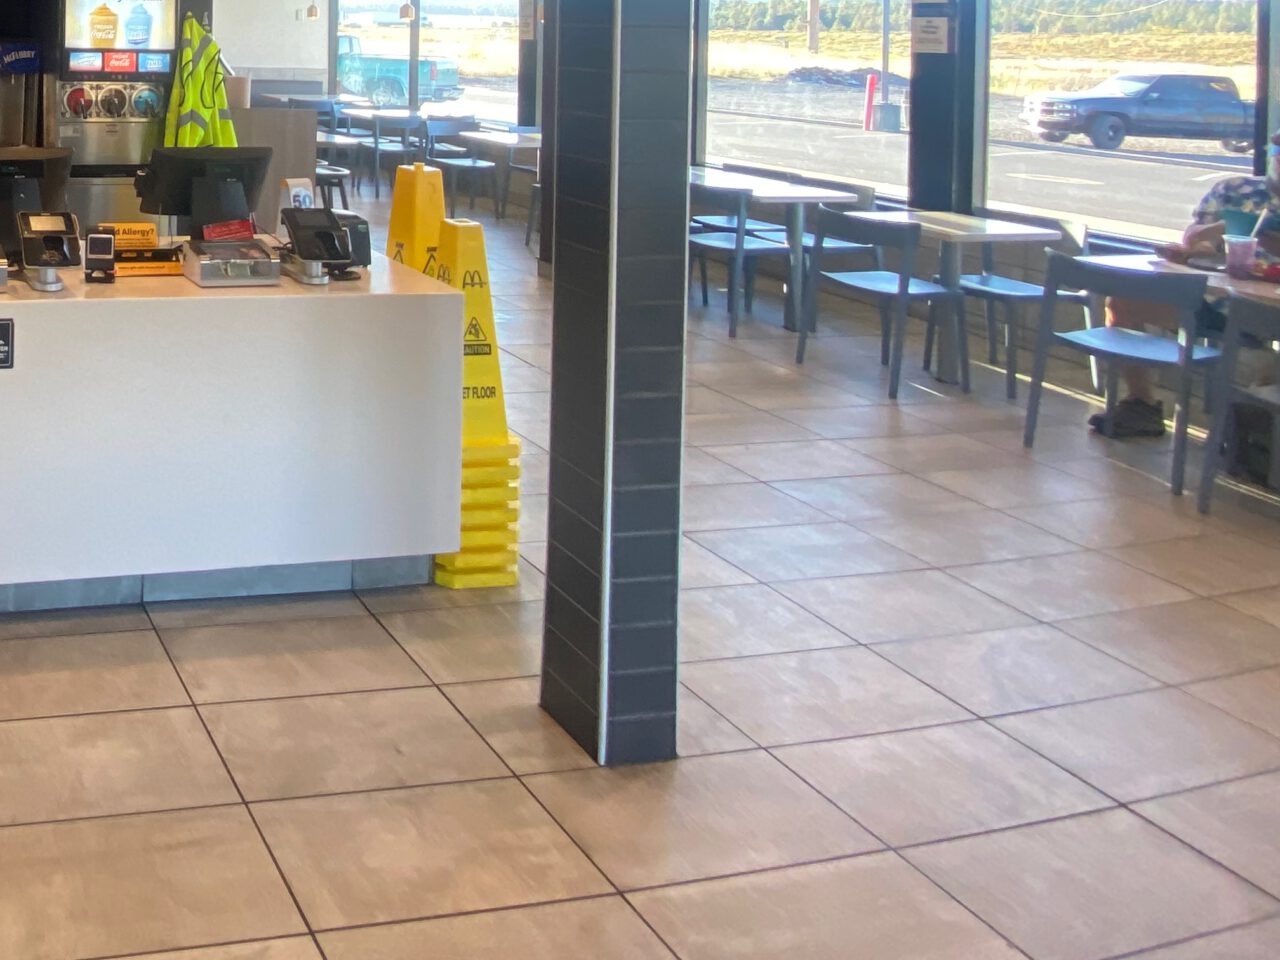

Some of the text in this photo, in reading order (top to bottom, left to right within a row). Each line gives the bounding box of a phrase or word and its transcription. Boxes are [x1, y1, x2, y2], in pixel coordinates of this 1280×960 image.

[122, 228, 154, 237] Allergy?
[464, 345, 490, 354] AUTION
[472, 386, 496, 399] FLOOR
